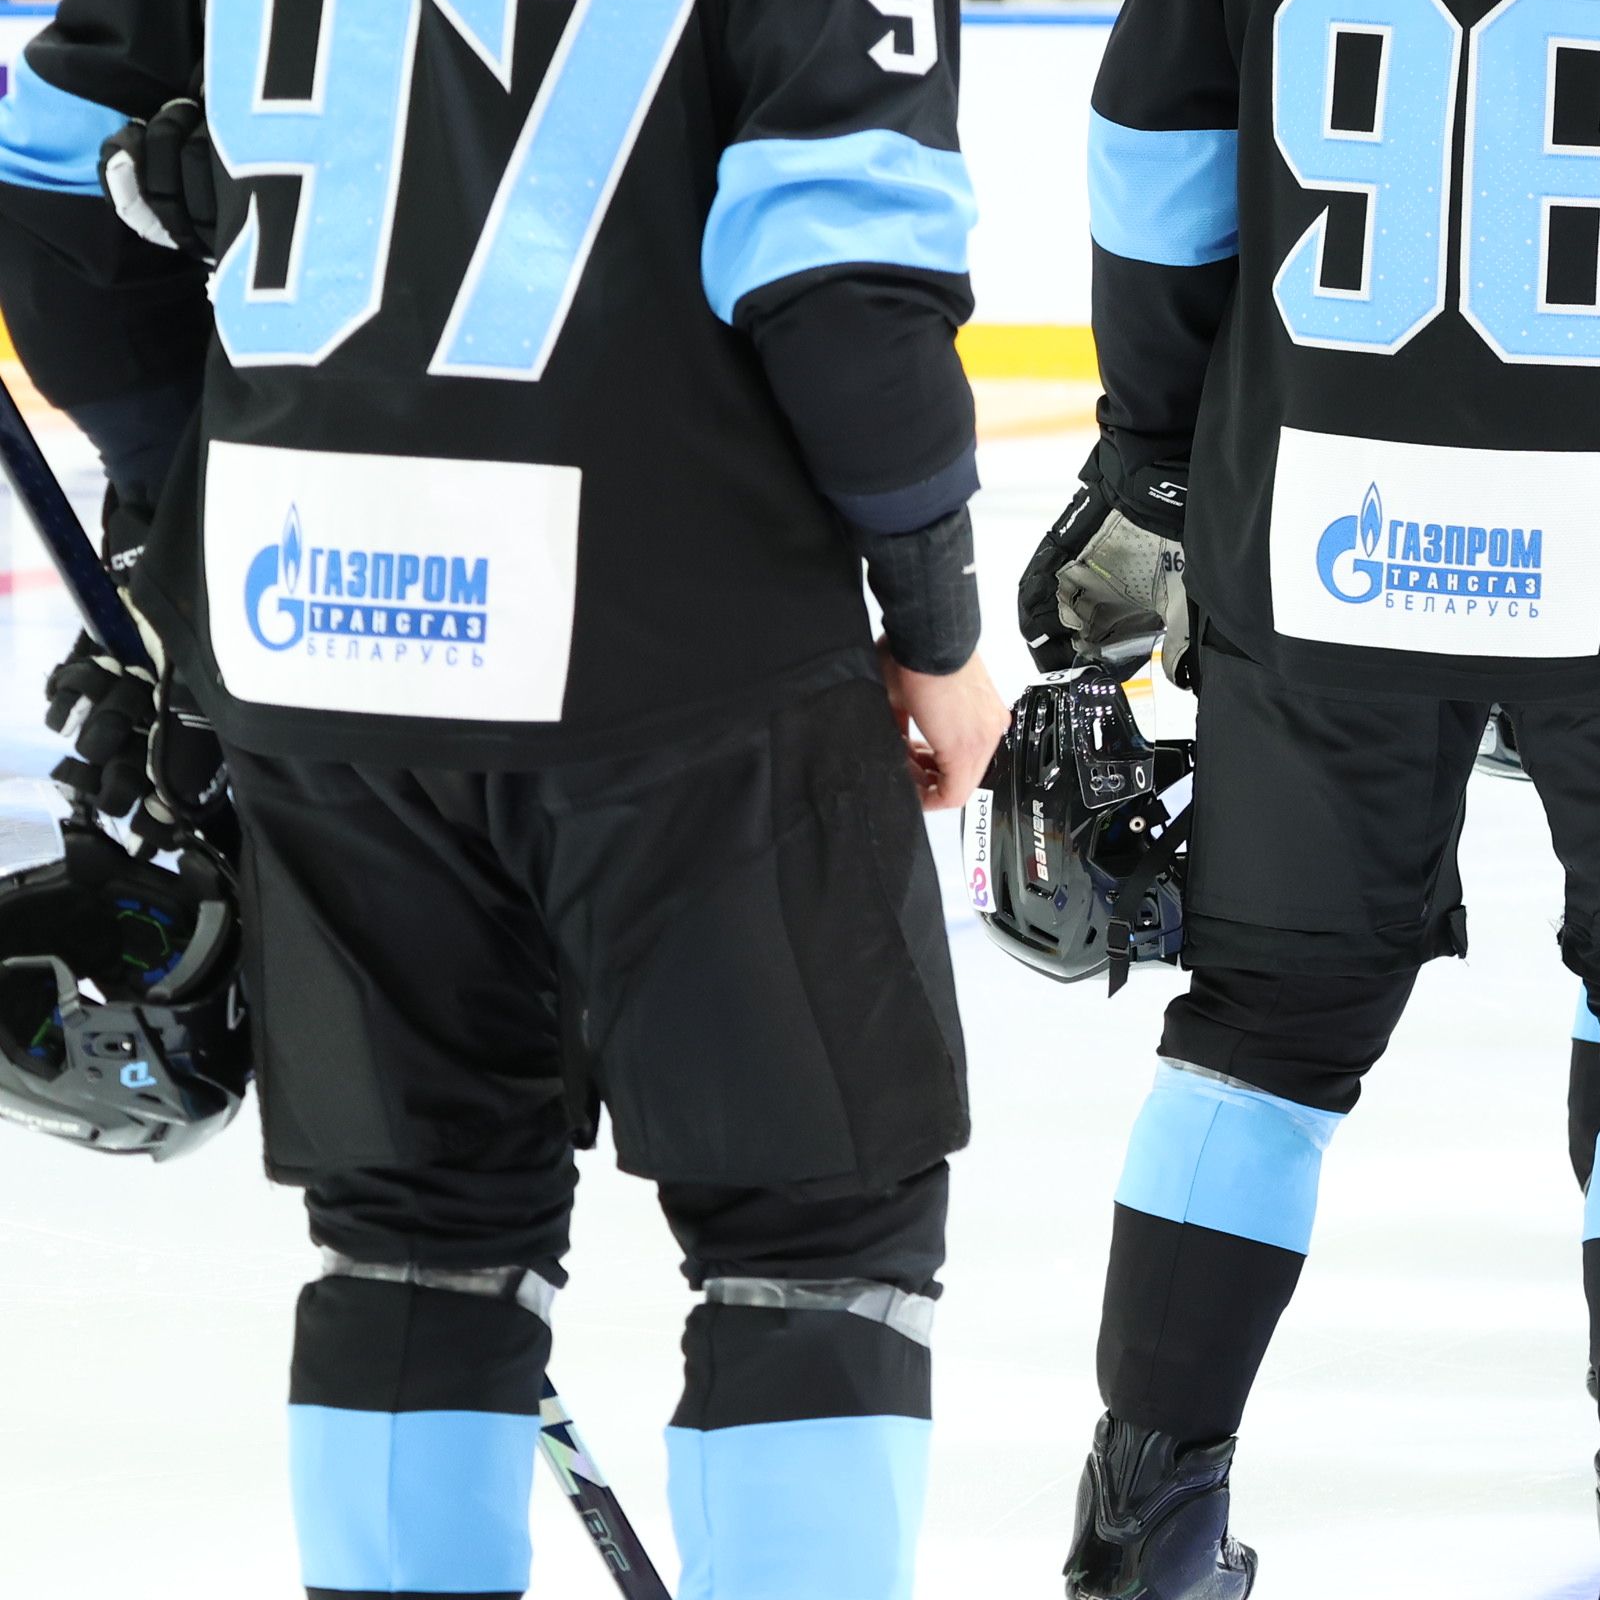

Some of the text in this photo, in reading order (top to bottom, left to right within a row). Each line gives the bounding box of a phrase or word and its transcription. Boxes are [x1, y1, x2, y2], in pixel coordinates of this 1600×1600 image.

[1387, 519, 1542, 569] ГАЗПРОМ
[309, 547, 489, 606] ГАЗПРОМ
[1163, 551, 1185, 573] 96
[1390, 568, 1537, 595] ТРАНСГАЗ
[1386, 593, 1540, 619] БЕЛАРУСЬ
[311, 606, 483, 640] ТРАНСГАЗ
[307, 637, 485, 668] БЕЛАРУСЬ
[975, 792, 989, 862] belbet
